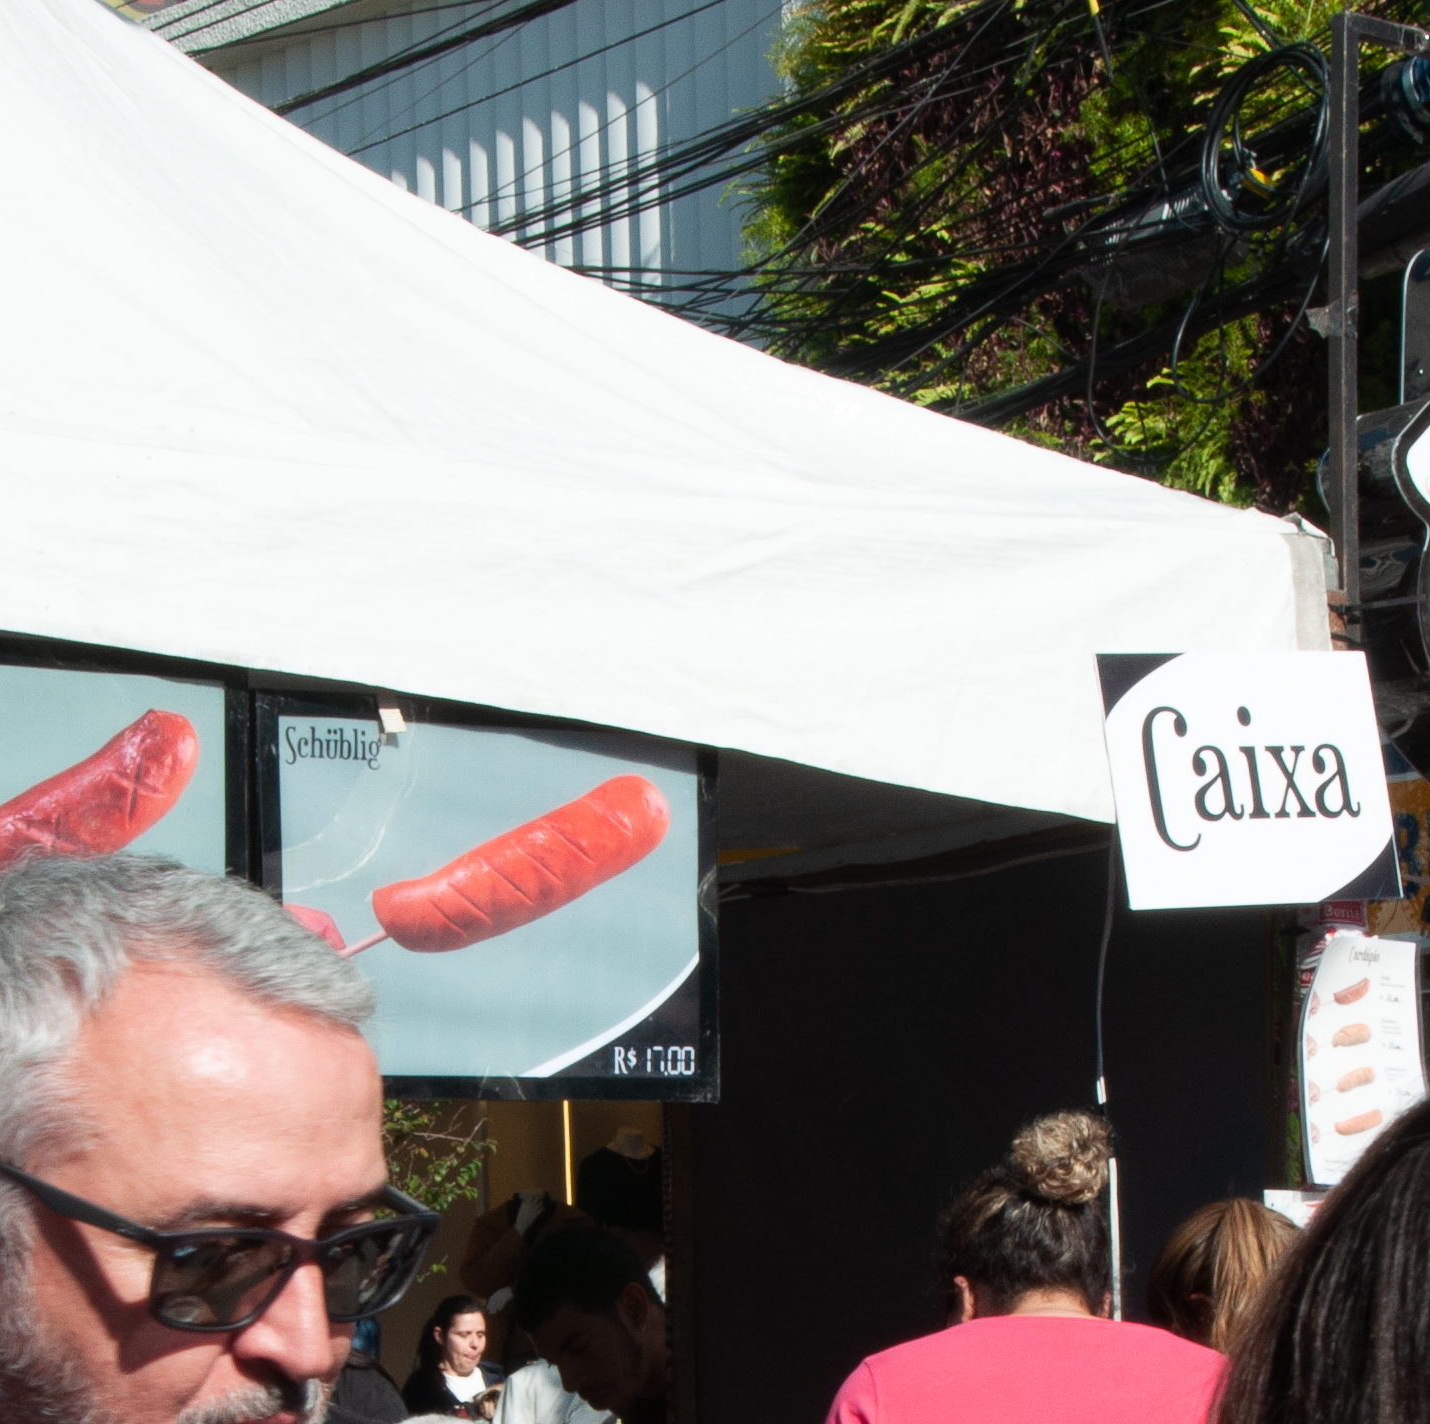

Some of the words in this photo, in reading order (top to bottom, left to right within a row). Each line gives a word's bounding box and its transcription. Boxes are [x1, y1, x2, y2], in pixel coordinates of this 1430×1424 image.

[285, 726, 382, 771] Schüblig
[1141, 706, 1361, 852] Caixa
[614, 1046, 638, 1075] R$
